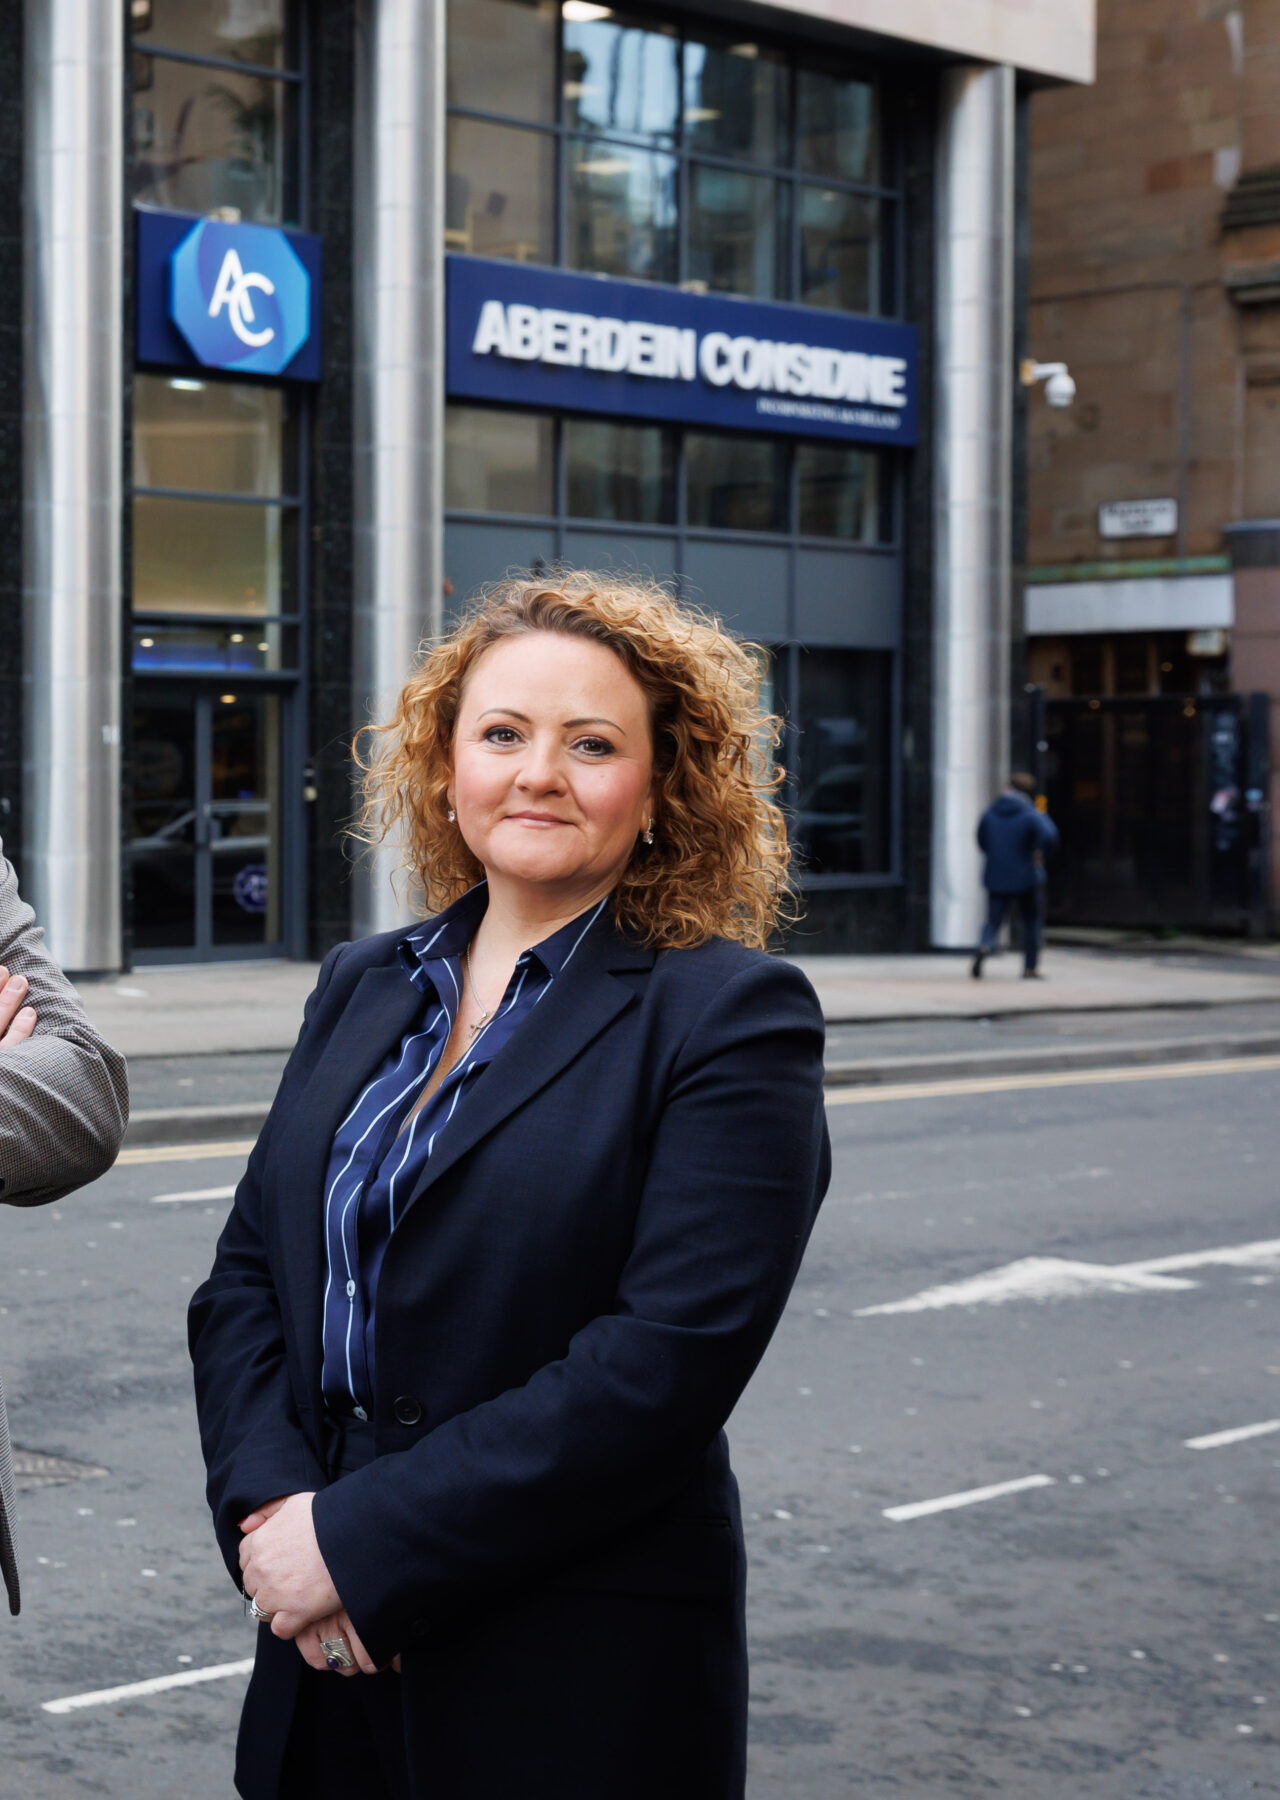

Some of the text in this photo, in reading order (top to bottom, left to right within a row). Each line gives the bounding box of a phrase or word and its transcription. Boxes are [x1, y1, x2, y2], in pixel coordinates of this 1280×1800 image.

[208, 248, 275, 347] AC
[472, 299, 907, 408] ABERDEIN CONSIDINE
